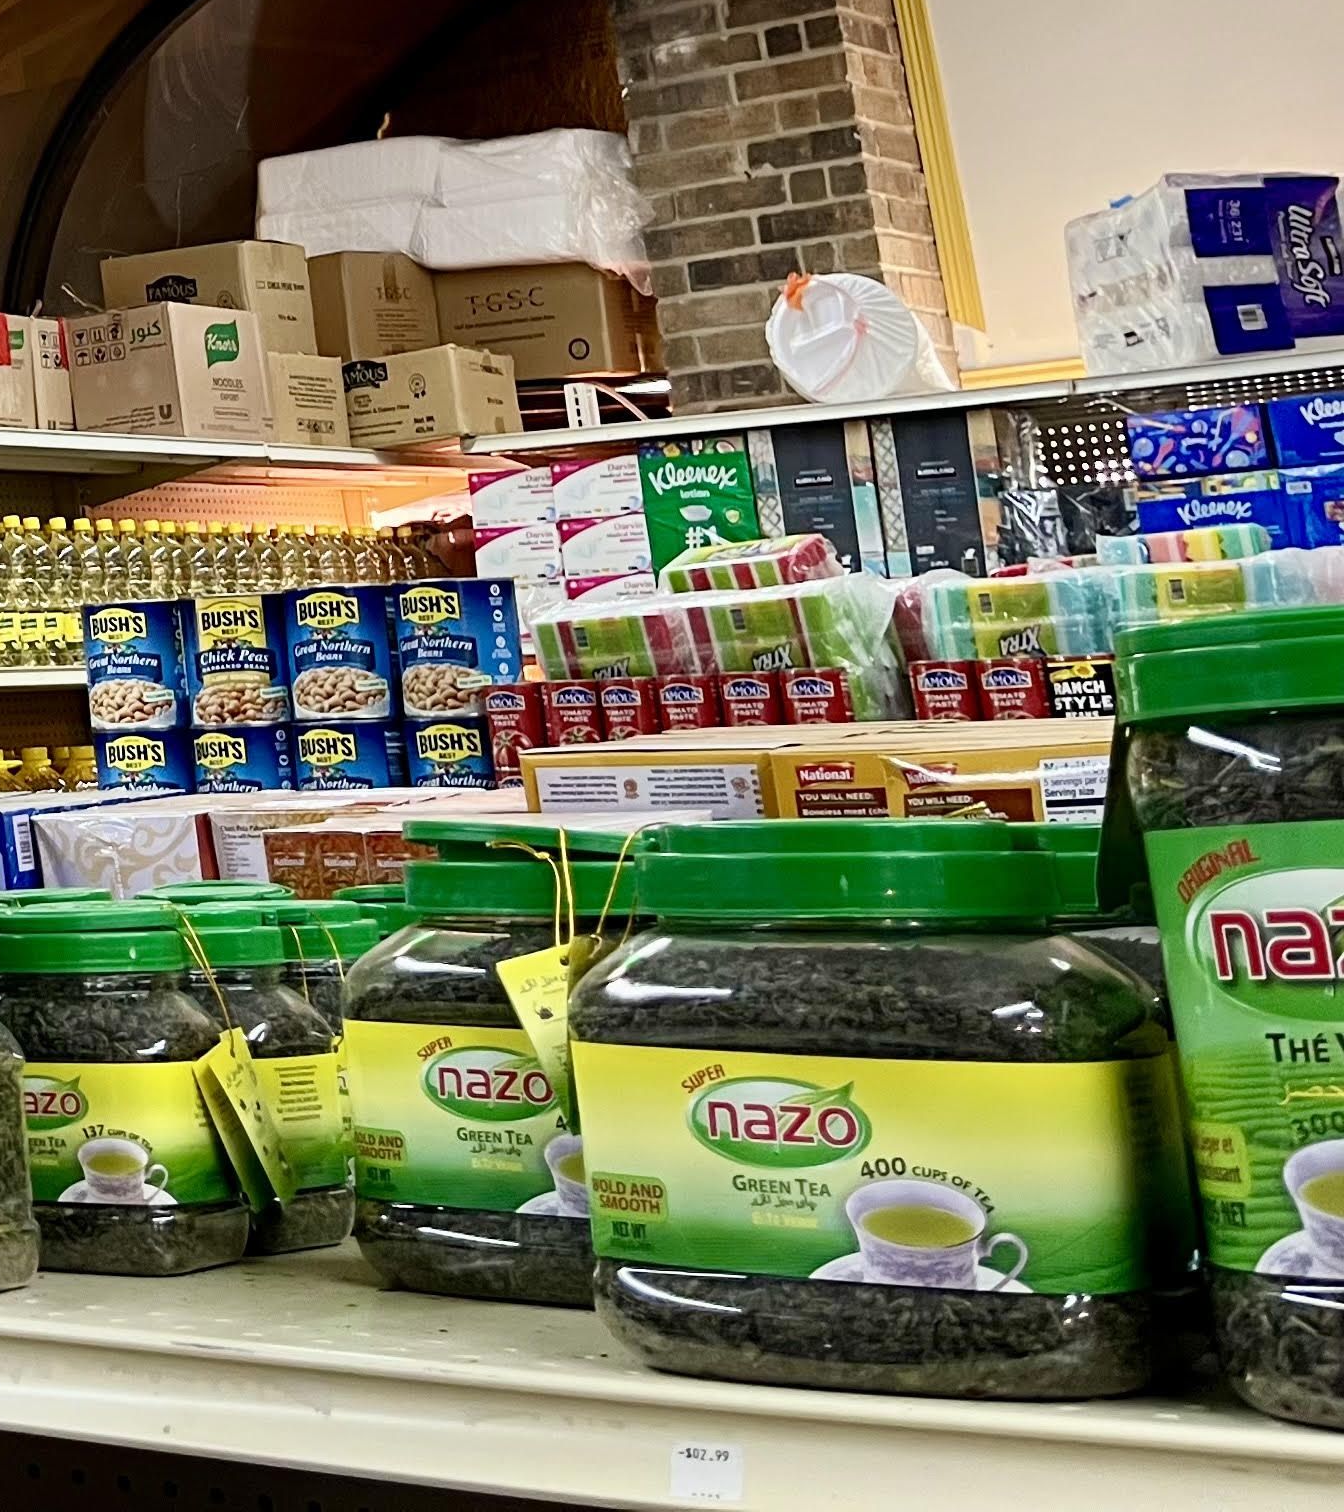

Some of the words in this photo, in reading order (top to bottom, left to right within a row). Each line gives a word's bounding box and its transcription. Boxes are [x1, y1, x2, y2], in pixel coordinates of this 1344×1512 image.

[1288, 205, 1313, 261] Ultra
[1294, 258, 1330, 308] Soft
[206, 333, 239, 353] Knorr
[212, 378, 244, 389] NOODLES
[607, 463, 636, 472] Darvin
[647, 462, 738, 494] Kleenex
[680, 489, 710, 500] lotion
[1177, 500, 1252, 526] Kleenex
[525, 530, 553, 539] Darvin
[613, 521, 644, 531] Darvin
[623, 580, 654, 589] Darvin
[299, 600, 356, 621] BUSH'S
[402, 594, 456, 617] BUSH'S
[92, 615, 143, 635] BUSH'S
[201, 609, 259, 631] BUSH'S
[222, 627, 239, 635] BEST
[294, 644, 318, 657] Great
[320, 640, 371, 655] Northern
[420, 636, 473, 651] Northern
[1000, 624, 1042, 656] XTRA
[111, 653, 158, 667] Northern
[200, 649, 236, 666] Chick
[239, 649, 269, 663] Peas
[315, 652, 343, 662] Beans
[417, 648, 443, 658] Beans
[752, 641, 794, 671] XTRA
[107, 665, 132, 674] Beans
[1055, 679, 1106, 694] RANCH
[925, 693, 961, 701] TOMATO
[929, 700, 958, 708] PASTE
[990, 692, 1026, 700] TOMATO
[994, 699, 1023, 707] PASTE
[1055, 695, 1113, 710] STYLE
[196, 740, 243, 760] BUSH'S
[300, 737, 354, 757] BUSH'S
[419, 733, 480, 754] BUSH'S
[108, 744, 162, 763] BUSH'S
[443, 774, 495, 787] Northern
[820, 793, 844, 801] WILL
[846, 792, 875, 801] NEED:
[908, 798, 924, 806] YOU
[925, 797, 946, 806] WILL
[1044, 788, 1076, 799] Serving
[1078, 787, 1096, 796] size
[1179, 838, 1260, 904] ORIGINAL
[416, 1036, 453, 1061] SUPER
[1264, 1031, 1331, 1064] THÉ
[437, 1067, 555, 1104] nazo
[681, 1064, 725, 1094] SUPER
[82, 1125, 104, 1138] 137
[706, 1098, 861, 1150] nazo
[48, 1137, 66, 1147] TEA
[378, 1135, 403, 1148] AND
[456, 1127, 502, 1143] GREEN
[505, 1129, 532, 1145] TEA
[357, 1145, 402, 1160] SMOOTH
[592, 1177, 626, 1195] BOLD
[630, 1182, 663, 1199] AND
[732, 1174, 791, 1196] GREEN
[794, 1178, 832, 1198] TEA
[860, 1156, 907, 1180] 400
[912, 1166, 948, 1182] CUPS
[951, 1175, 972, 1191] OF
[973, 1187, 996, 1214] TEA
[599, 1194, 661, 1214] SMOOTH
[612, 1221, 630, 1237] NET
[631, 1224, 646, 1238] WT
